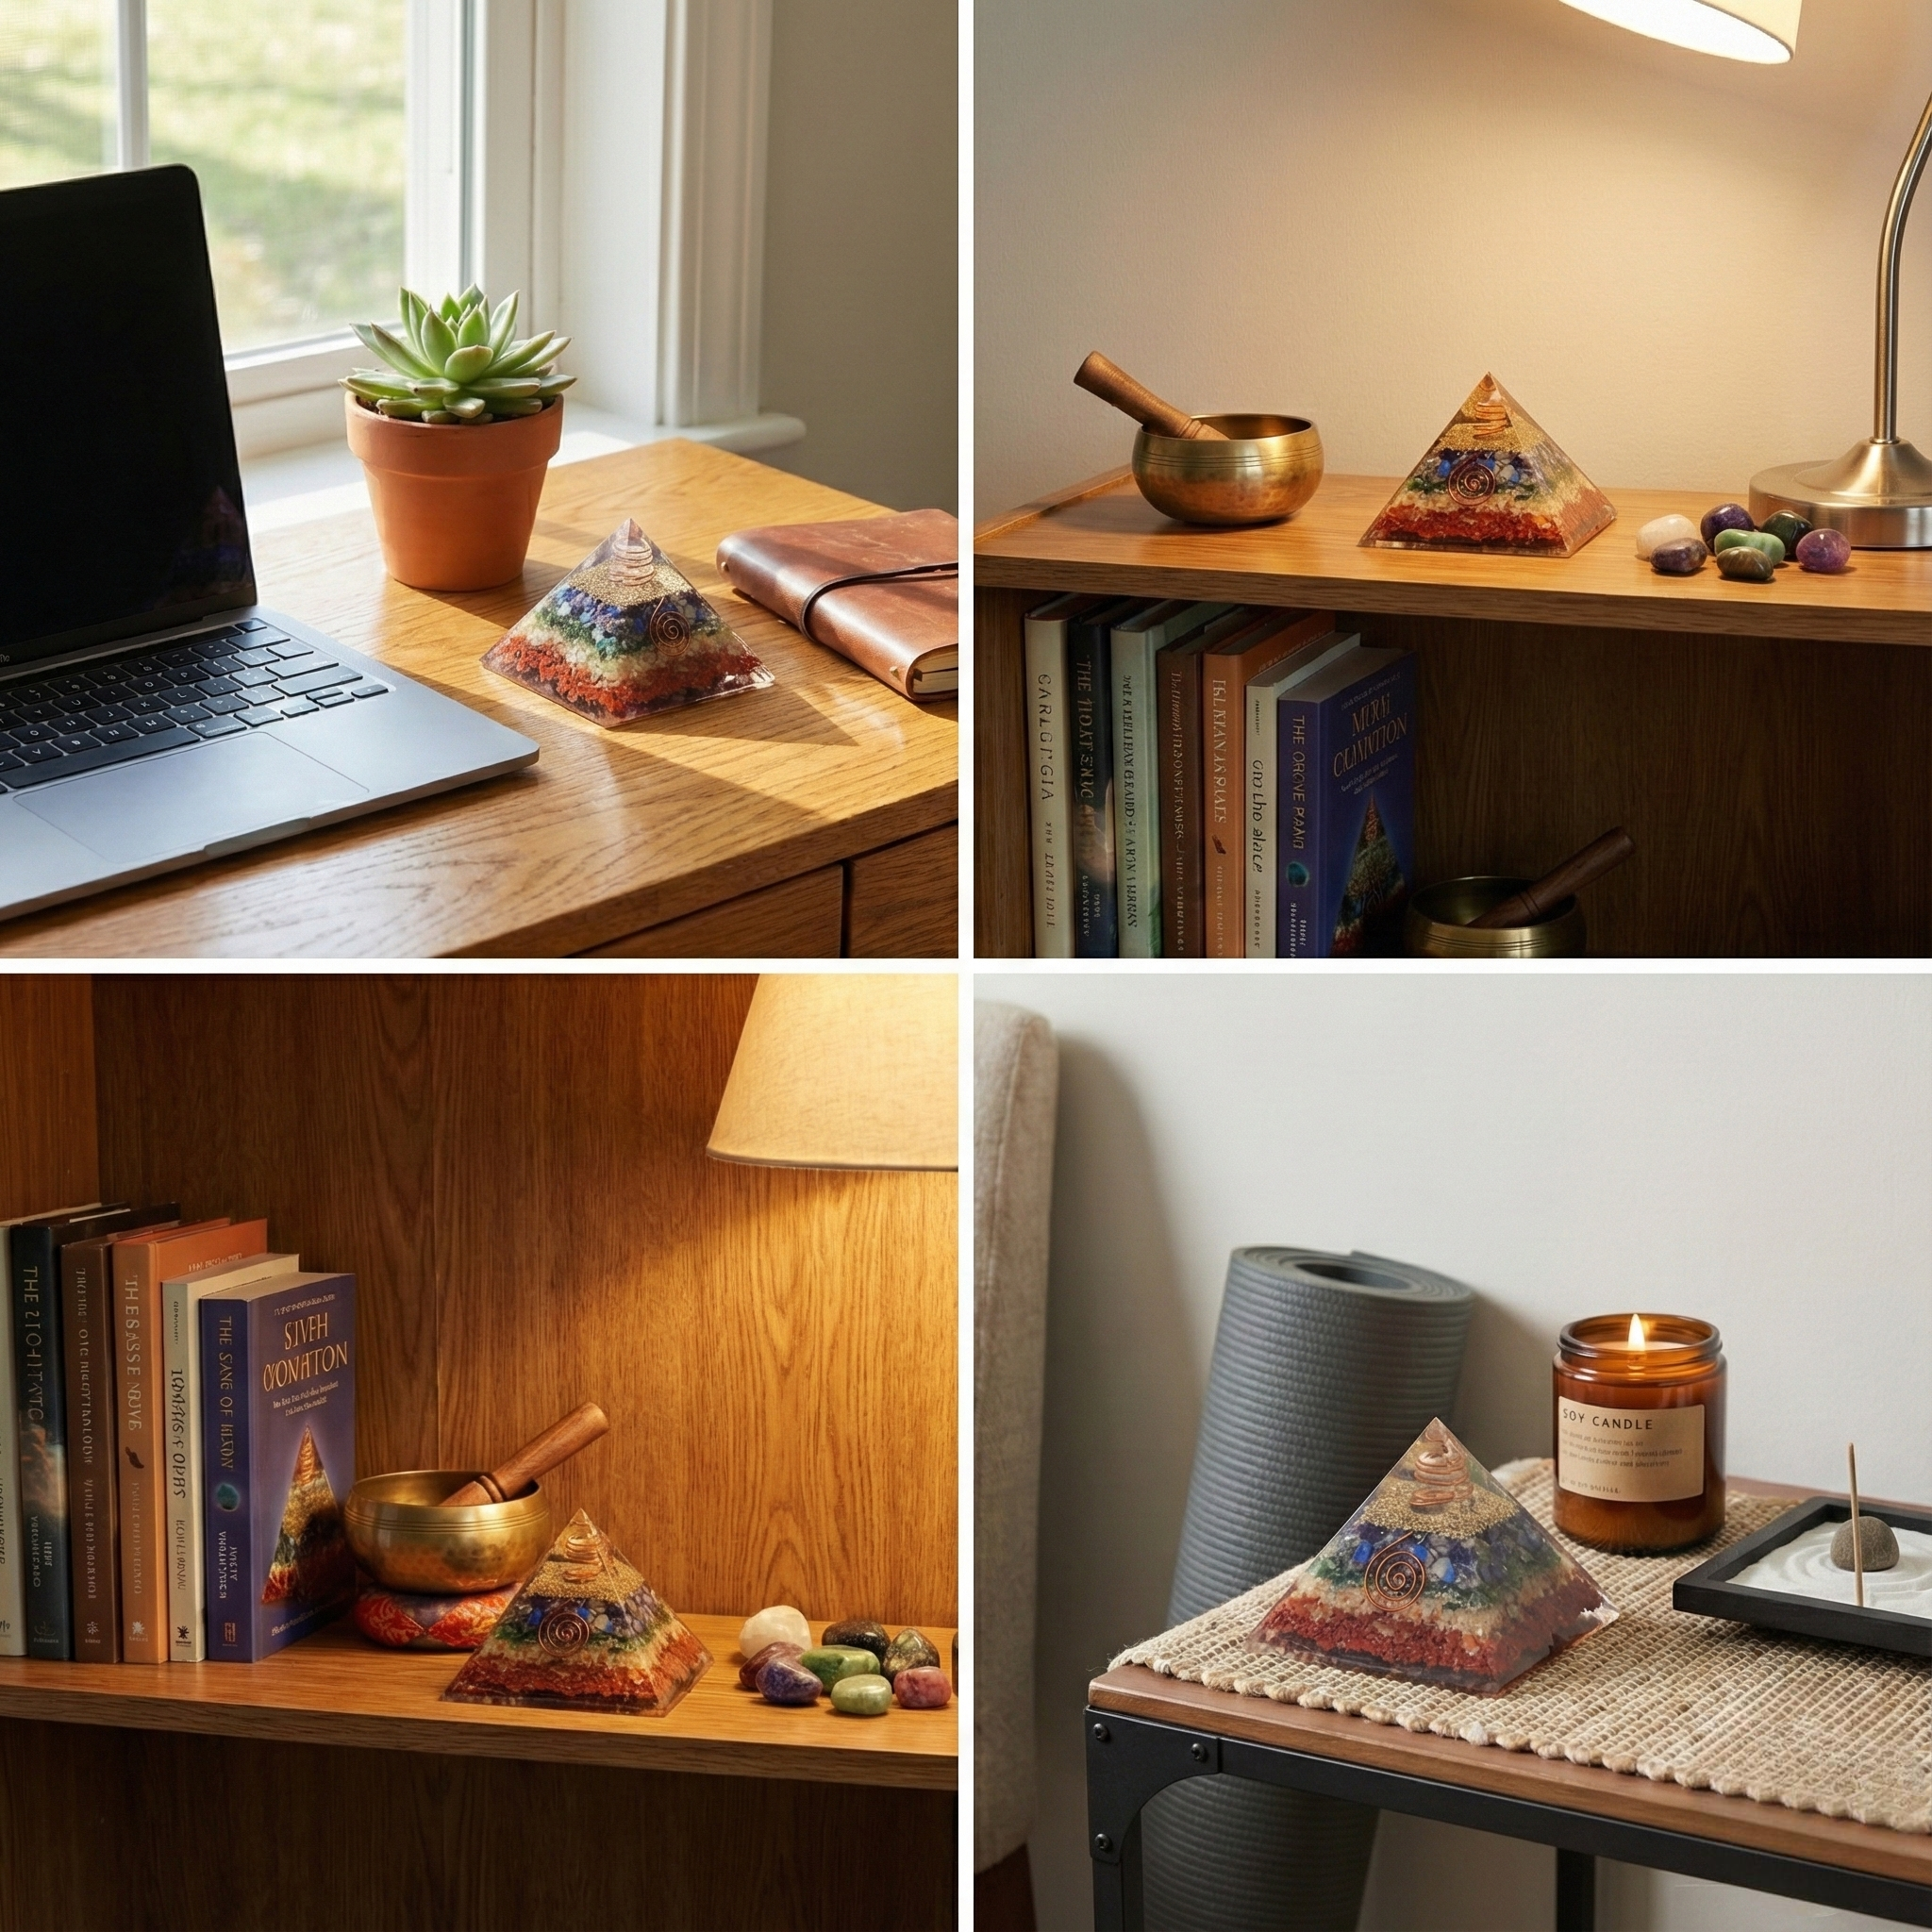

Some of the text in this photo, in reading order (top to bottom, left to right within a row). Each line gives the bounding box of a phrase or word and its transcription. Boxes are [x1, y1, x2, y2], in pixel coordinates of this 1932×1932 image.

[1076, 660, 1091, 691] THE
[1292, 715, 1306, 745] THE
[23, 1266, 40, 1303] THE
[219, 1316, 232, 1345] THE
[220, 1396, 233, 1418] OF
[1562, 1408, 1654, 1430] SOY CANDLE
